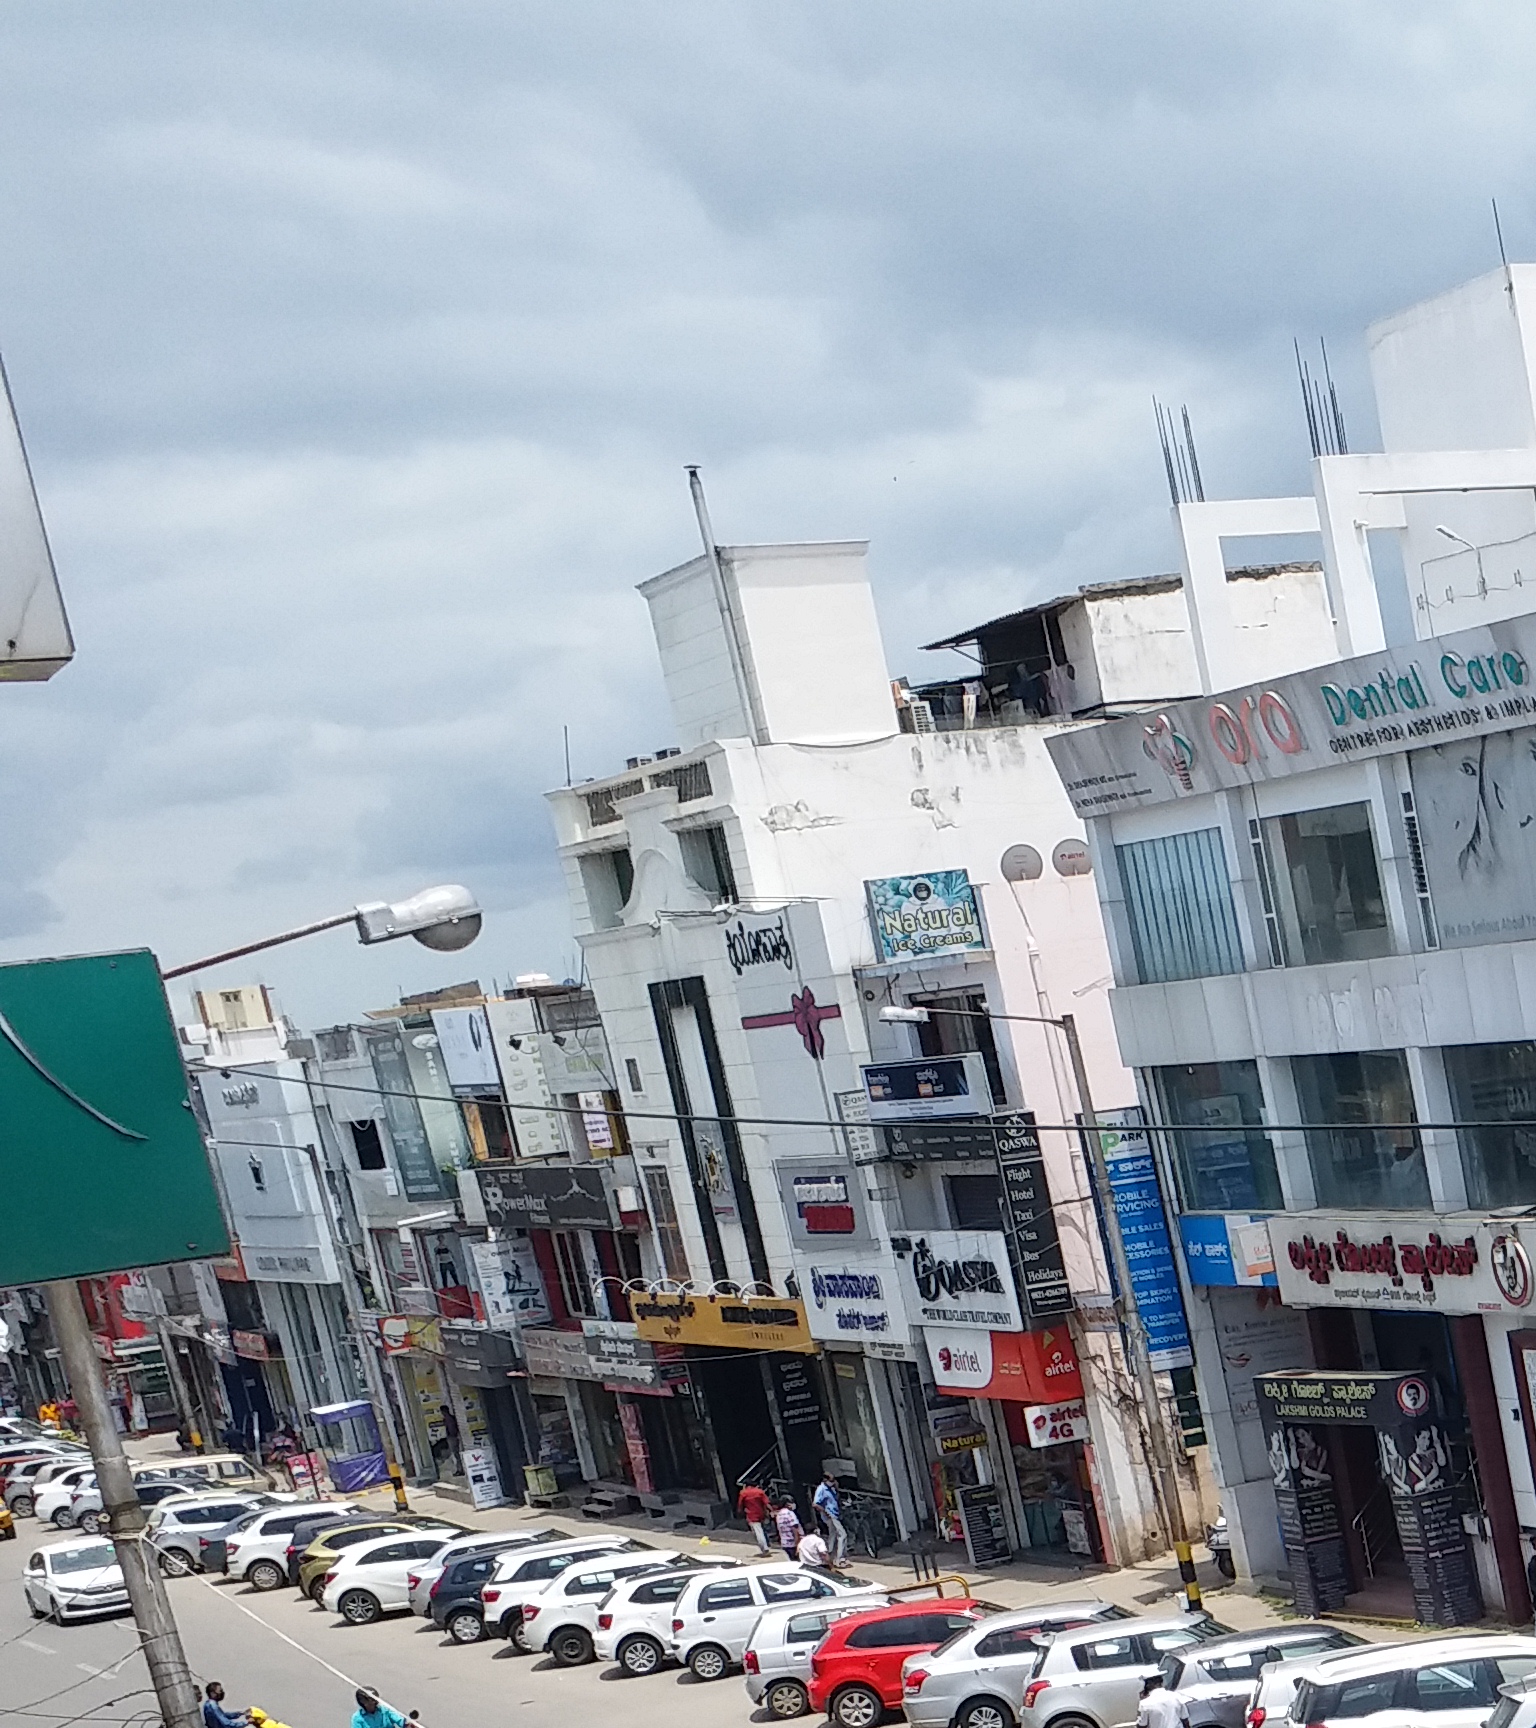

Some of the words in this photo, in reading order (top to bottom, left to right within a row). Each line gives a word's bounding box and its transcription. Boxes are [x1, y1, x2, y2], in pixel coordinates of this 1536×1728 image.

[1321, 662, 1434, 727] Dental
[1440, 649, 1529, 699] Care
[1328, 729, 1375, 754] CENTRE
[1377, 723, 1402, 744] FOR
[1407, 706, 1480, 738] AESTHETICS
[882, 902, 975, 935] Natural
[892, 935, 917, 952] Ice
[920, 930, 975, 947] Creams
[1000, 1137, 1038, 1151] QASWA
[1006, 1168, 1033, 1182] Flight
[1010, 1189, 1034, 1202] Hotel
[1014, 1209, 1034, 1222] Taxi
[1018, 1229, 1038, 1242] Visa
[1023, 1250, 1041, 1262] Bus
[1026, 1268, 1064, 1283] Holidays
[953, 1350, 983, 1374] airtel
[1045, 1360, 1076, 1377] airtel
[783, 1405, 820, 1418] BROTHER
[1049, 1403, 1086, 1423] airtel
[1274, 1404, 1308, 1419] LAKSHMI
[1307, 1405, 1336, 1419] GOLDS
[1336, 1405, 1368, 1419] PALACE
[1049, 1422, 1074, 1441] 4G
[941, 1430, 988, 1450] Natural
